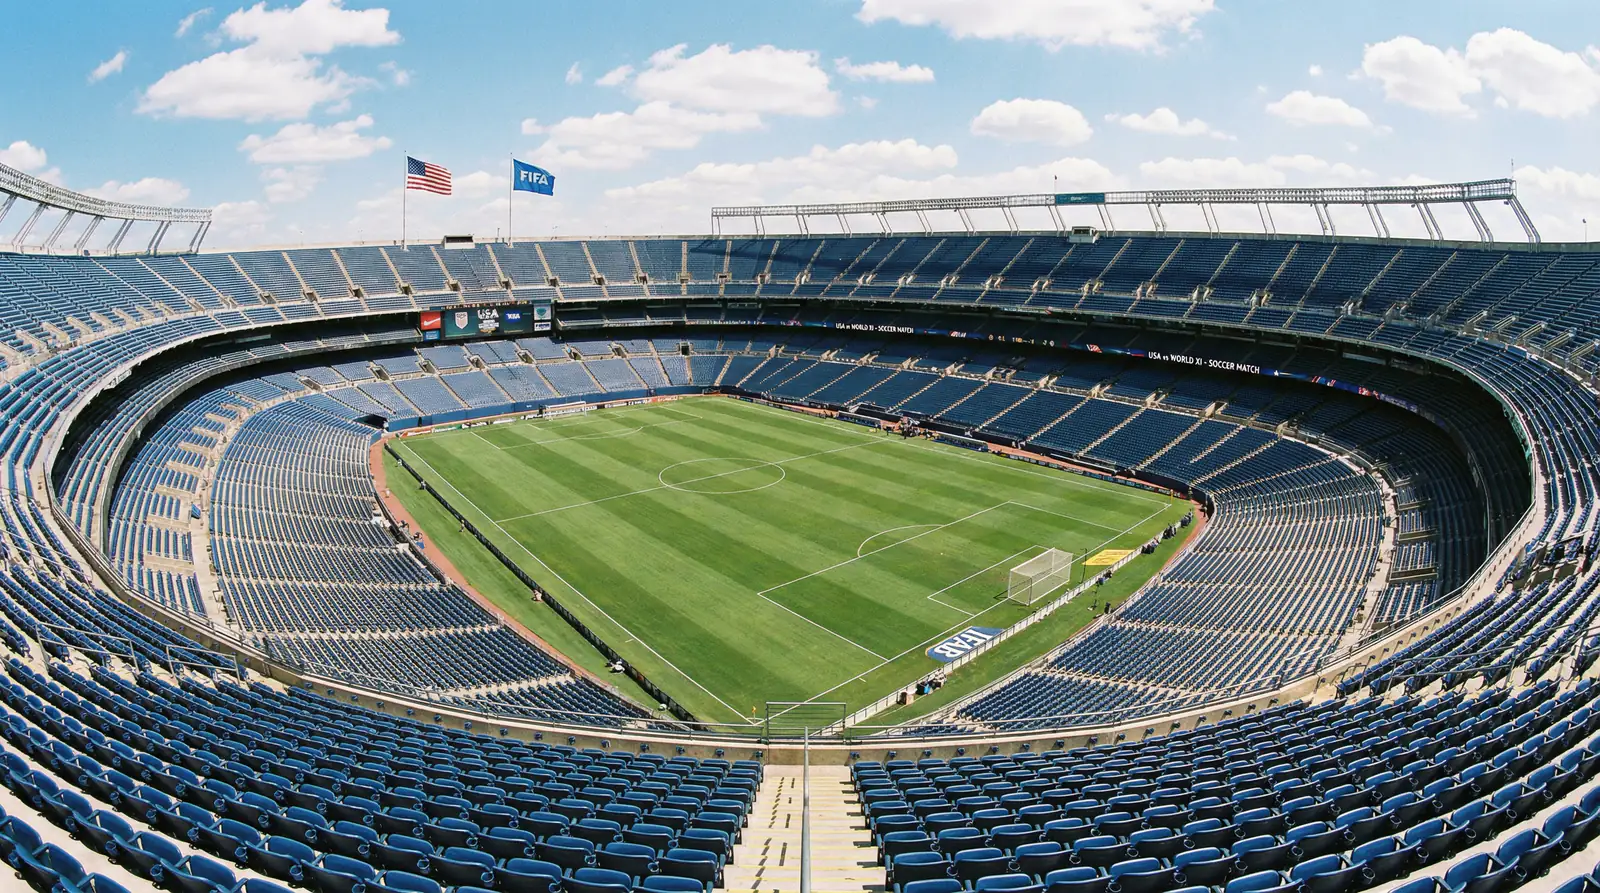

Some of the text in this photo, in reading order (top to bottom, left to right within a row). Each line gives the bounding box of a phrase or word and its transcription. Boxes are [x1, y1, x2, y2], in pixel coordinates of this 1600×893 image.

[520, 170, 549, 185] FIFA
[835, 322, 845, 330] USA
[851, 323, 868, 331] WORLD
[897, 326, 914, 334] MATCH
[1148, 351, 1161, 360] USA
[1170, 353, 1194, 365] WORLD
[1195, 357, 1203, 366] XI
[1208, 359, 1235, 370] SOCCER
[1236, 363, 1260, 374] MATCH
[933, 629, 993, 658] IFAB
